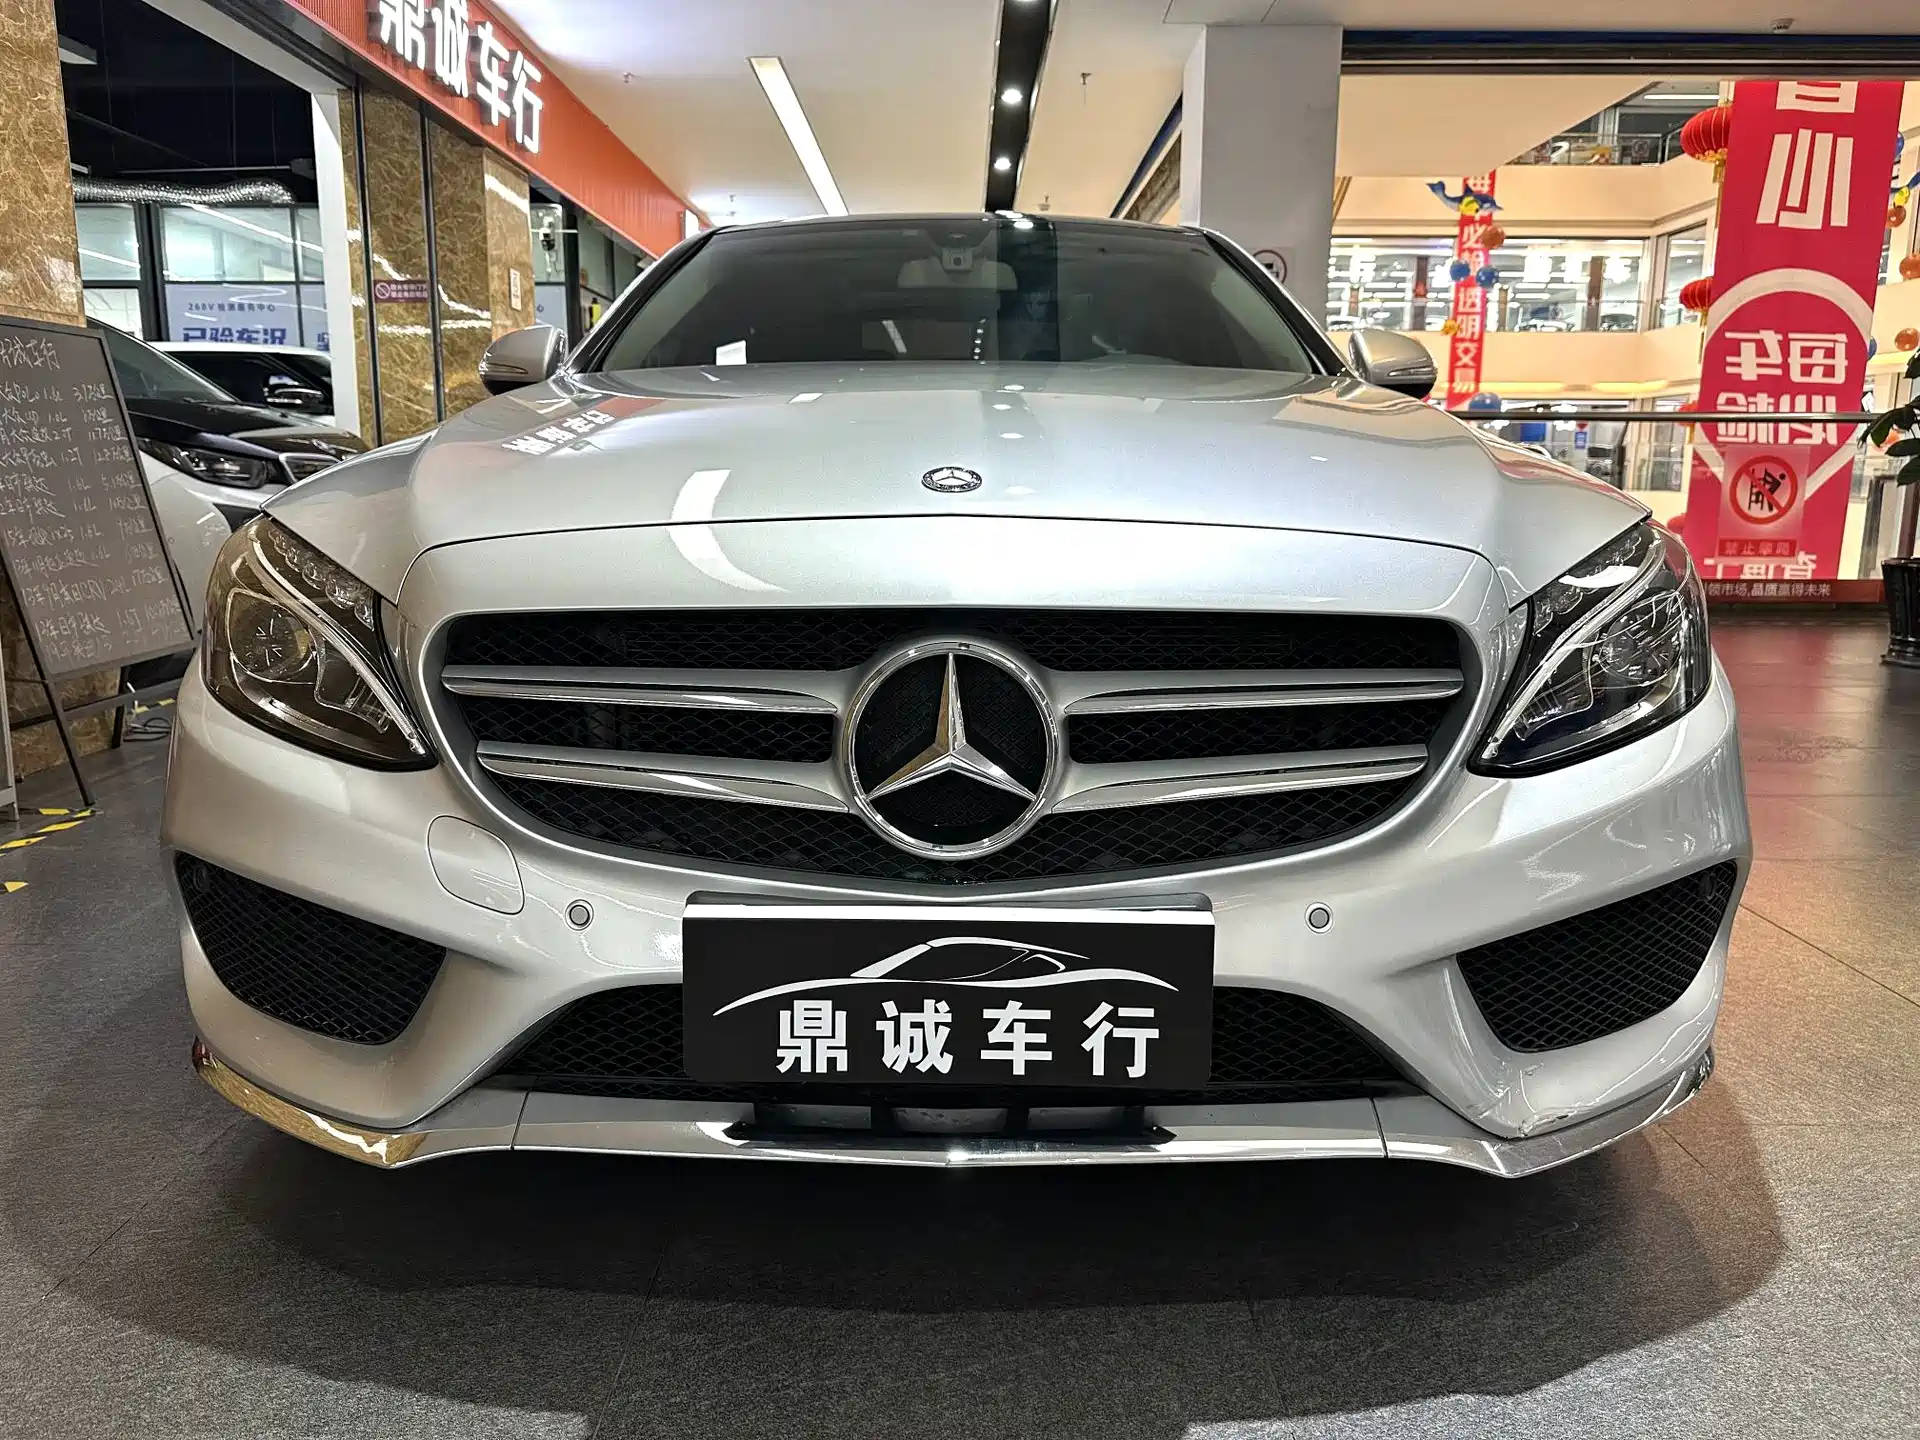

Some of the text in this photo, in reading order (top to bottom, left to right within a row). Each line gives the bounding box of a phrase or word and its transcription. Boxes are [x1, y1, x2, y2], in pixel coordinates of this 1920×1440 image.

[183, 327, 287, 346] 已验车况
[1704, 582, 1832, 598] 领市场,品质赢得未来
[775, 998, 1160, 1079] 鼎诚车行
